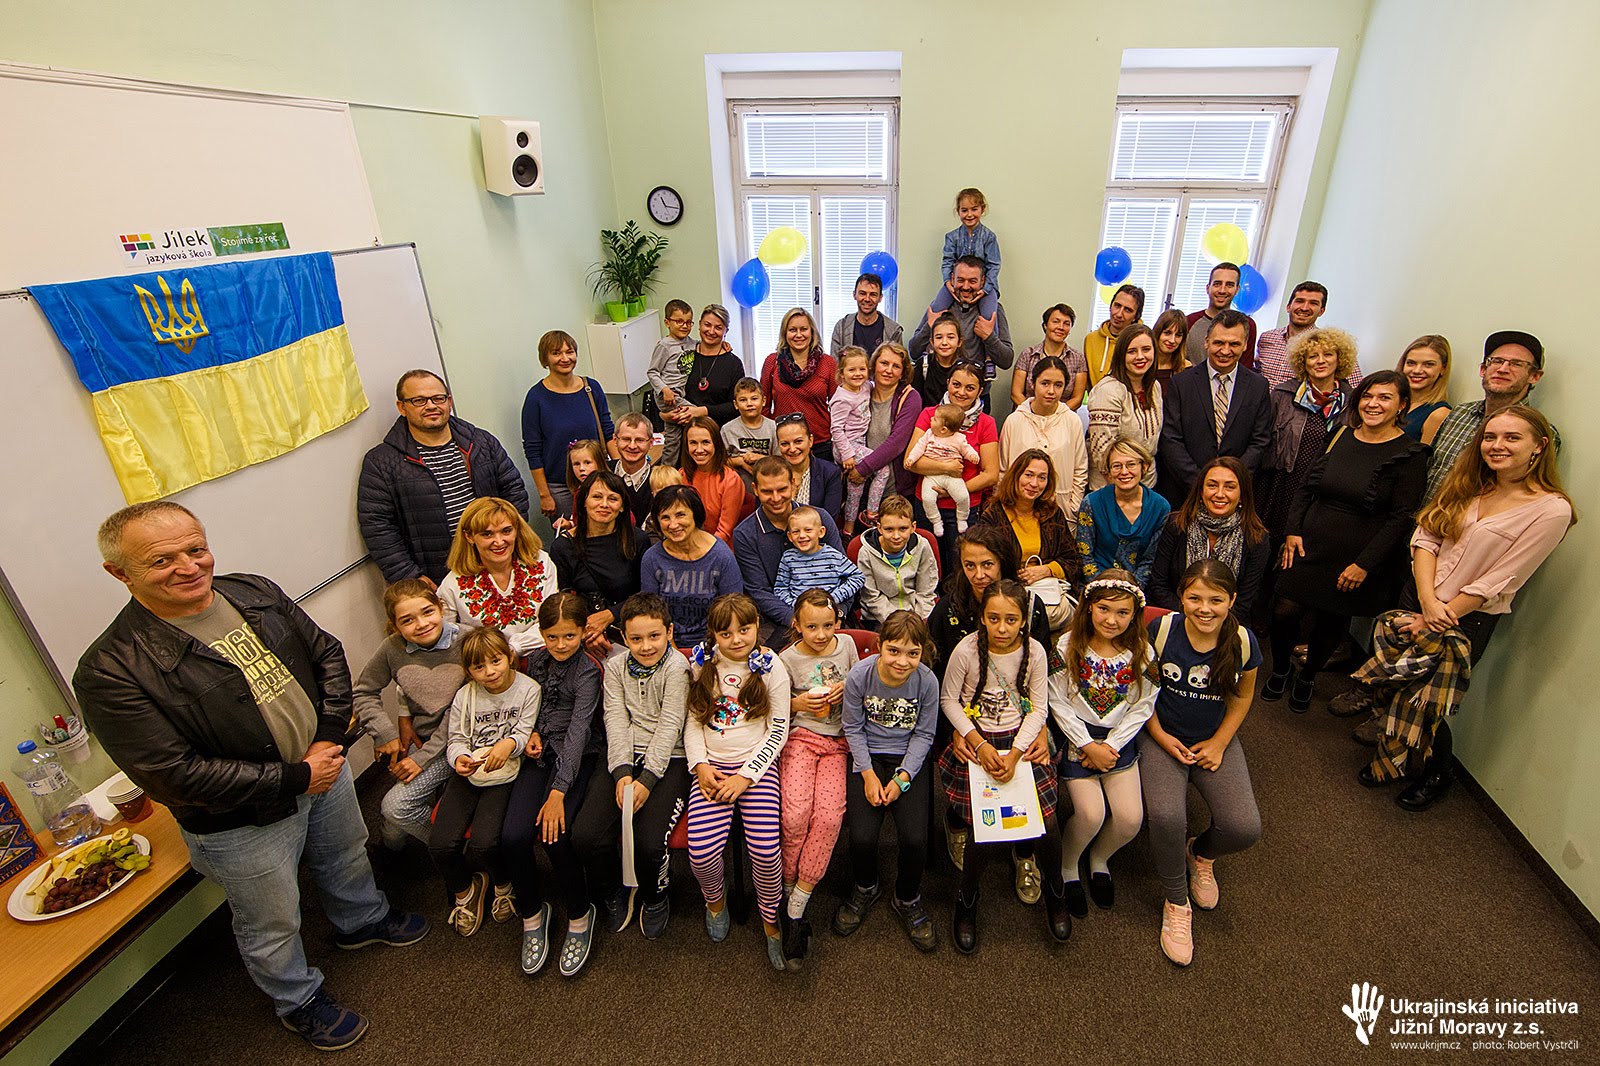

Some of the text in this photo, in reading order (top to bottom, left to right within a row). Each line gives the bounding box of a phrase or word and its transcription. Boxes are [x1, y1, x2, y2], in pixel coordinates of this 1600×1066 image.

[162, 230, 209, 249] Jílek
[254, 236, 264, 244] za
[145, 248, 213, 265] jazyková škola
[683, 596, 713, 606] SECO
[682, 606, 709, 617] THIN
[504, 709, 519, 720] THE
[748, 717, 786, 773] DINOLICIOUS
